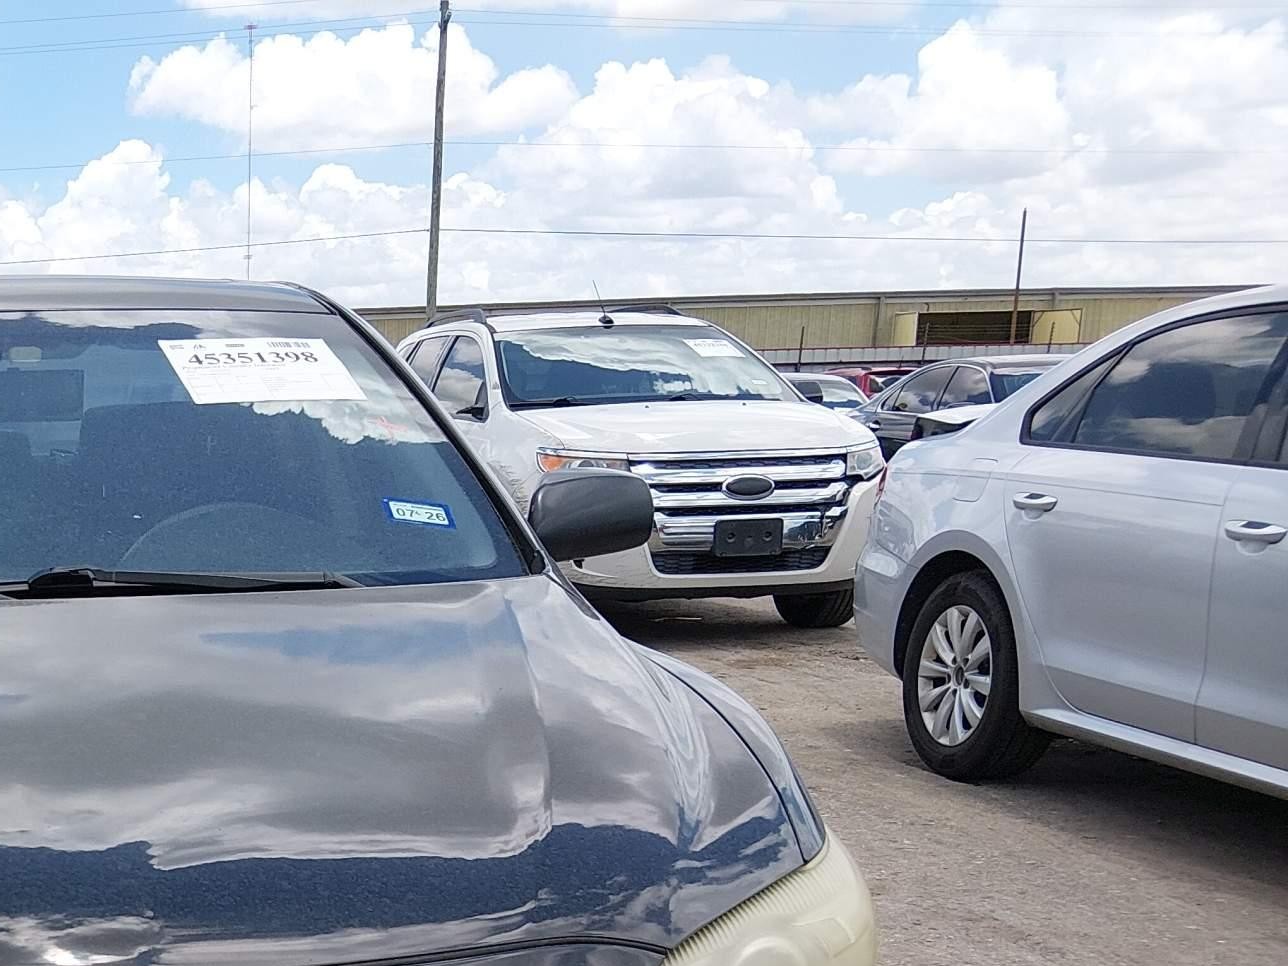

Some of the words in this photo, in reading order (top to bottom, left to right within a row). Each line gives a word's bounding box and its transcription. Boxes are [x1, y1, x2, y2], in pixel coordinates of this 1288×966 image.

[188, 351, 319, 366] 45351398
[395, 507, 414, 518] 07
[424, 511, 447, 522] 26
